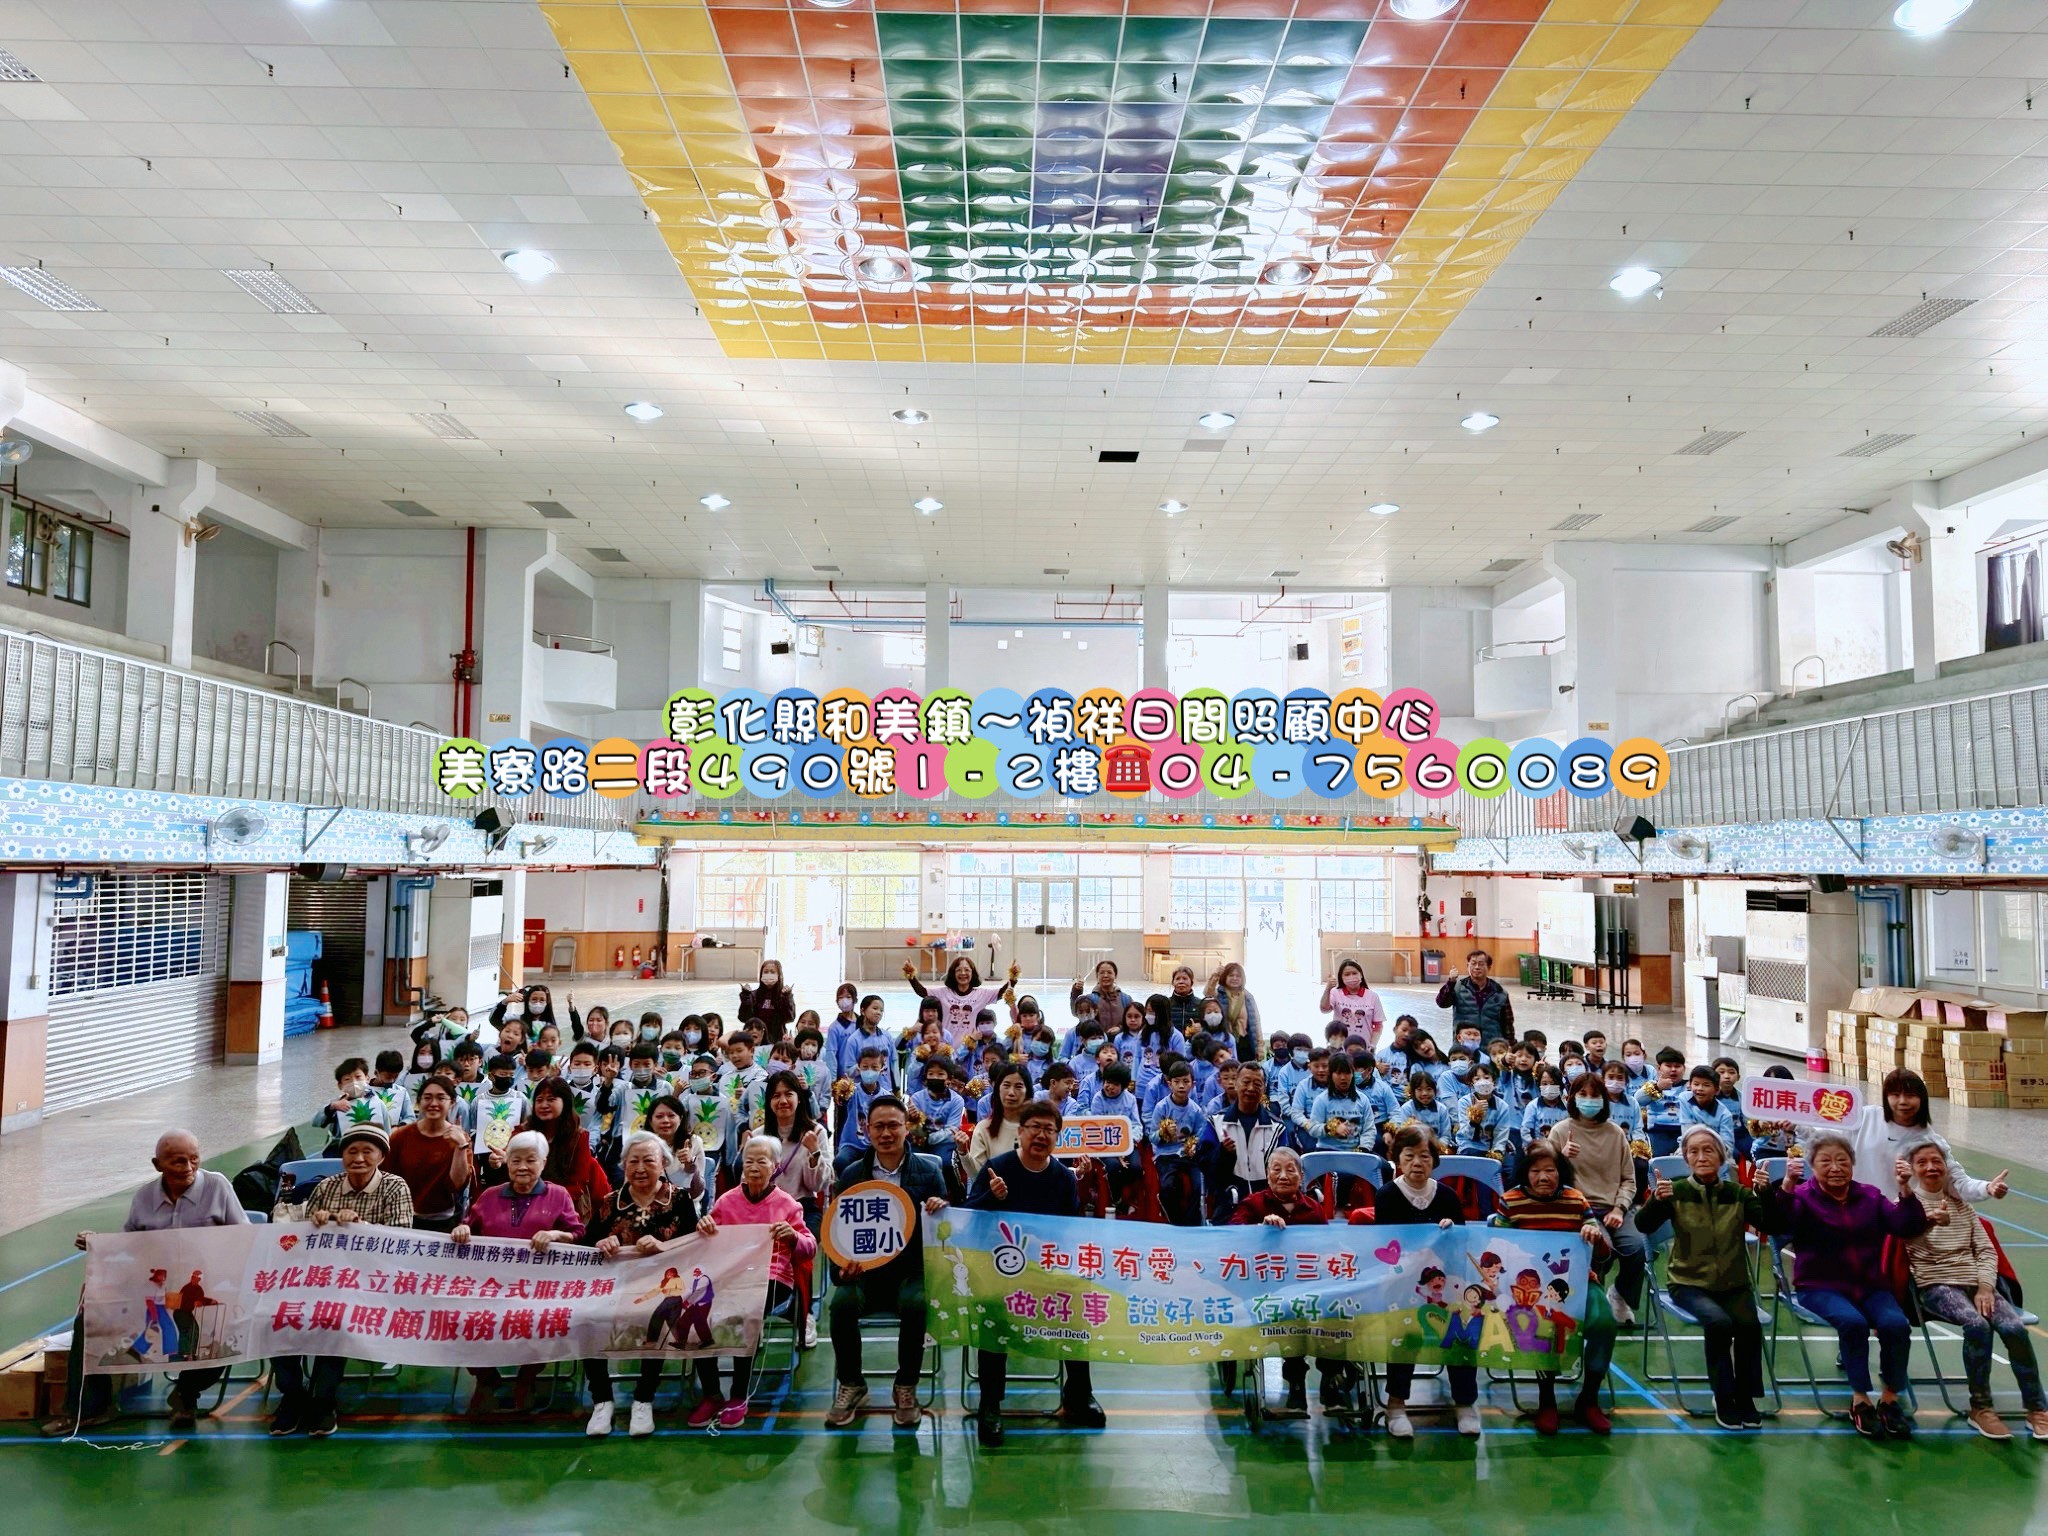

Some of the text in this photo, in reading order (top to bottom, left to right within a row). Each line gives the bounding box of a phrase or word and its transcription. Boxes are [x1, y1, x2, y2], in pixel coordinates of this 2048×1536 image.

[1752, 1087, 1849, 1122] 和東有愛
[840, 1196, 890, 1224] 和東
[853, 1226, 904, 1254] 國小
[252, 1264, 617, 1300] 彰化縣私立禎祥綜合式服務類
[271, 1301, 573, 1342] 長期照顧服務機構
[1004, 1290, 1361, 1327] 做好事 說好話 存好心
[1024, 1326, 1091, 1340] Do Good Deeds
[1140, 1331, 1224, 1343] Speak Good Words
[1261, 1326, 1353, 1339] Think Good Thoughts
[1417, 1303, 1577, 1354] SMART
